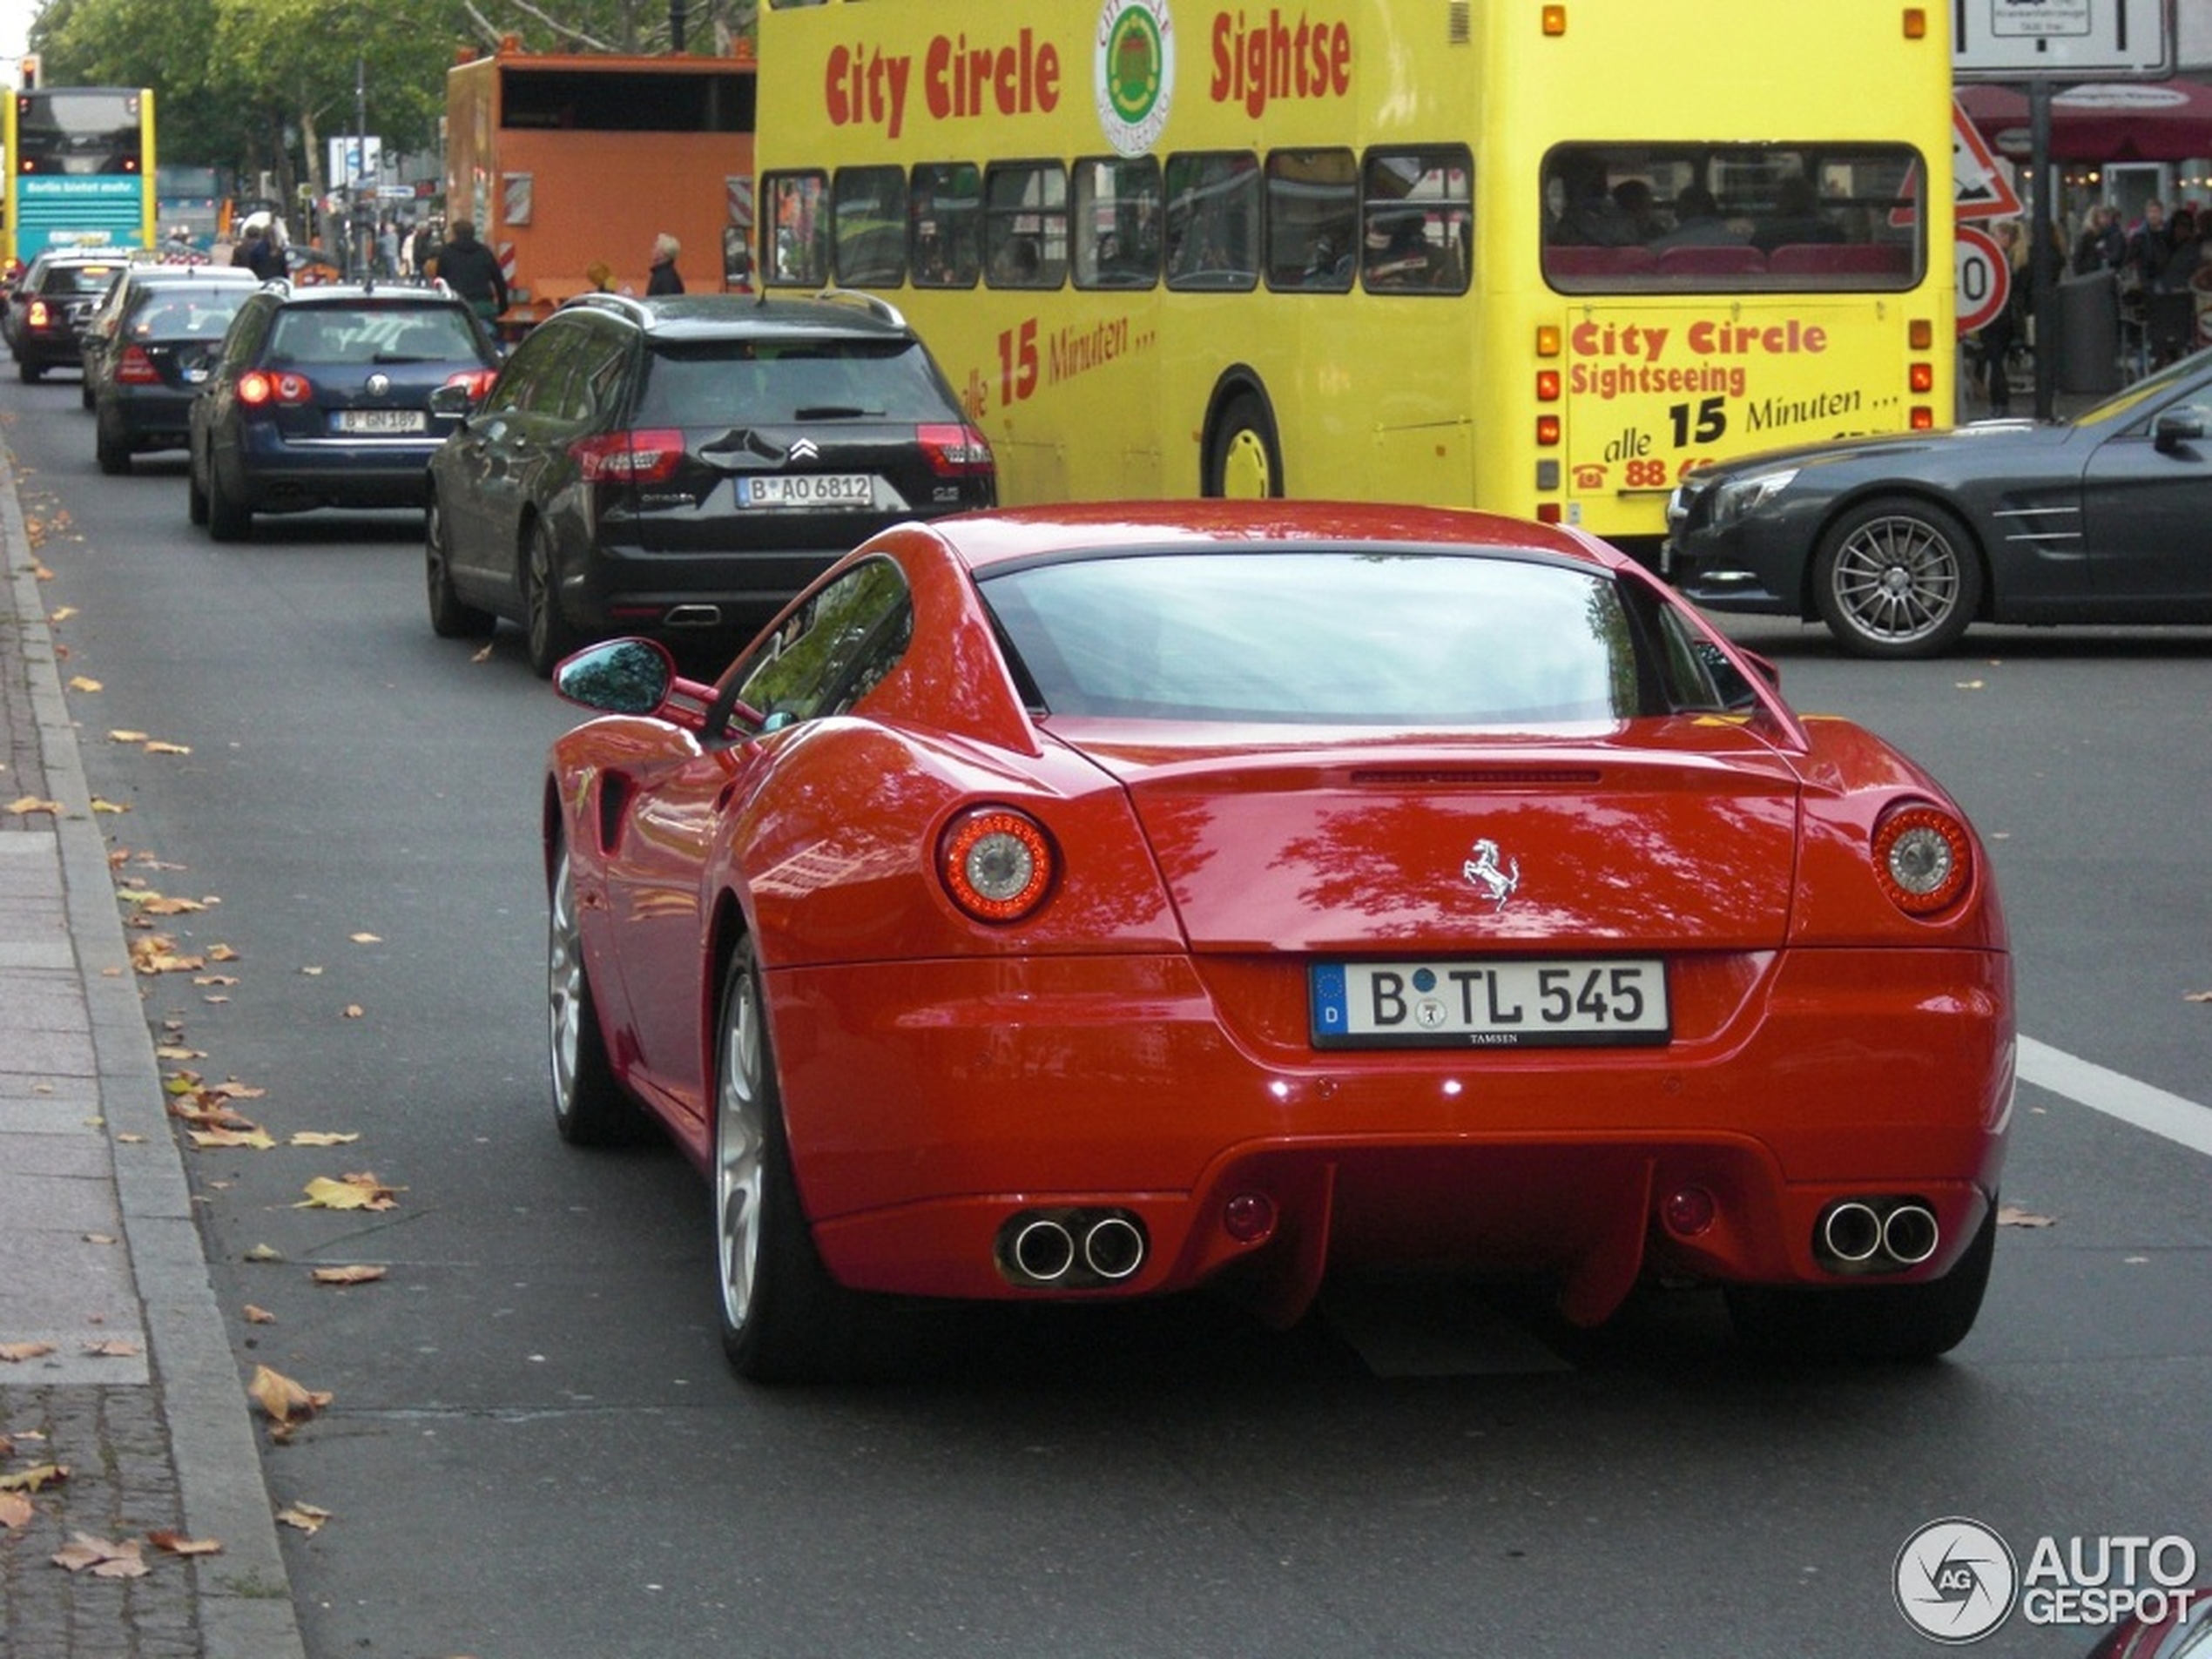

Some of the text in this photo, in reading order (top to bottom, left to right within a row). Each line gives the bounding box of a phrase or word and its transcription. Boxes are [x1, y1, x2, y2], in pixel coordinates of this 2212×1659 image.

[825, 28, 1060, 139] City Circle
[1211, 8, 1352, 120] Sightse
[1572, 320, 1826, 361] City Circle
[998, 317, 1039, 407] 15
[1048, 316, 1129, 386] Minuten
[1571, 362, 1746, 400] Sightseeing
[346, 413, 355, 427] B
[1603, 427, 1653, 463] alle
[1669, 396, 1729, 448] 15
[1745, 389, 1861, 434] Minuten
[752, 480, 766, 499] B
[815, 477, 869, 498] 6812
[1625, 458, 1667, 488] 88
[1325, 1007, 1339, 1023] D
[1371, 968, 1644, 1026] B TL 545
